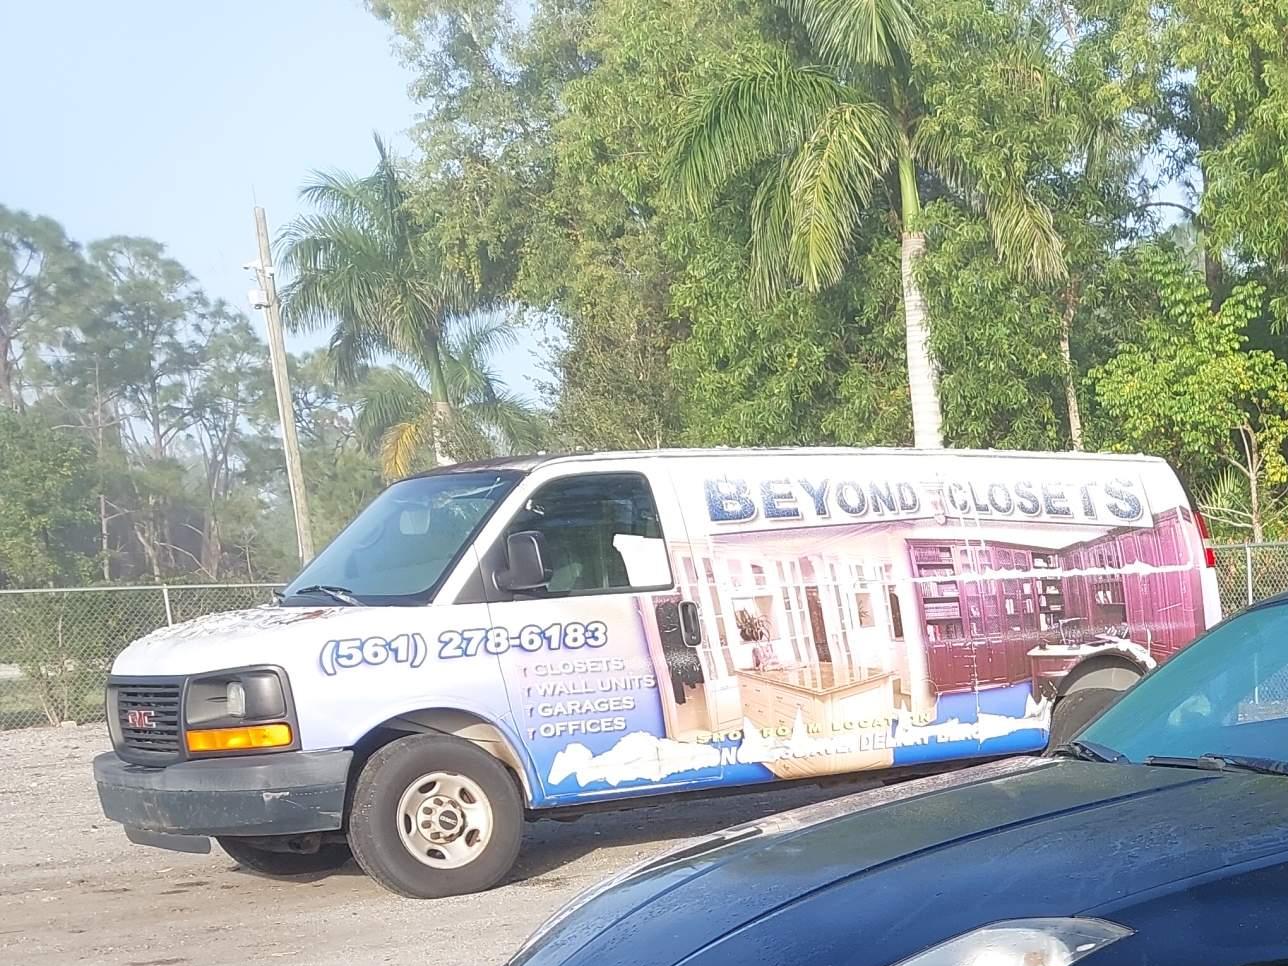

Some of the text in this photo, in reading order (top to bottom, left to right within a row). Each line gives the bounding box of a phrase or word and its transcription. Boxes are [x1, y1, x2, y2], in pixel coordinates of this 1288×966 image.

[704, 477, 1144, 524] BEYOND CLOSETS
[320, 621, 609, 676] (561) 278-6183
[535, 658, 625, 677] CLOSETS
[539, 674, 657, 697] WALL UNITS
[538, 696, 636, 717] GARAGES
[540, 717, 627, 737] OFFICES
